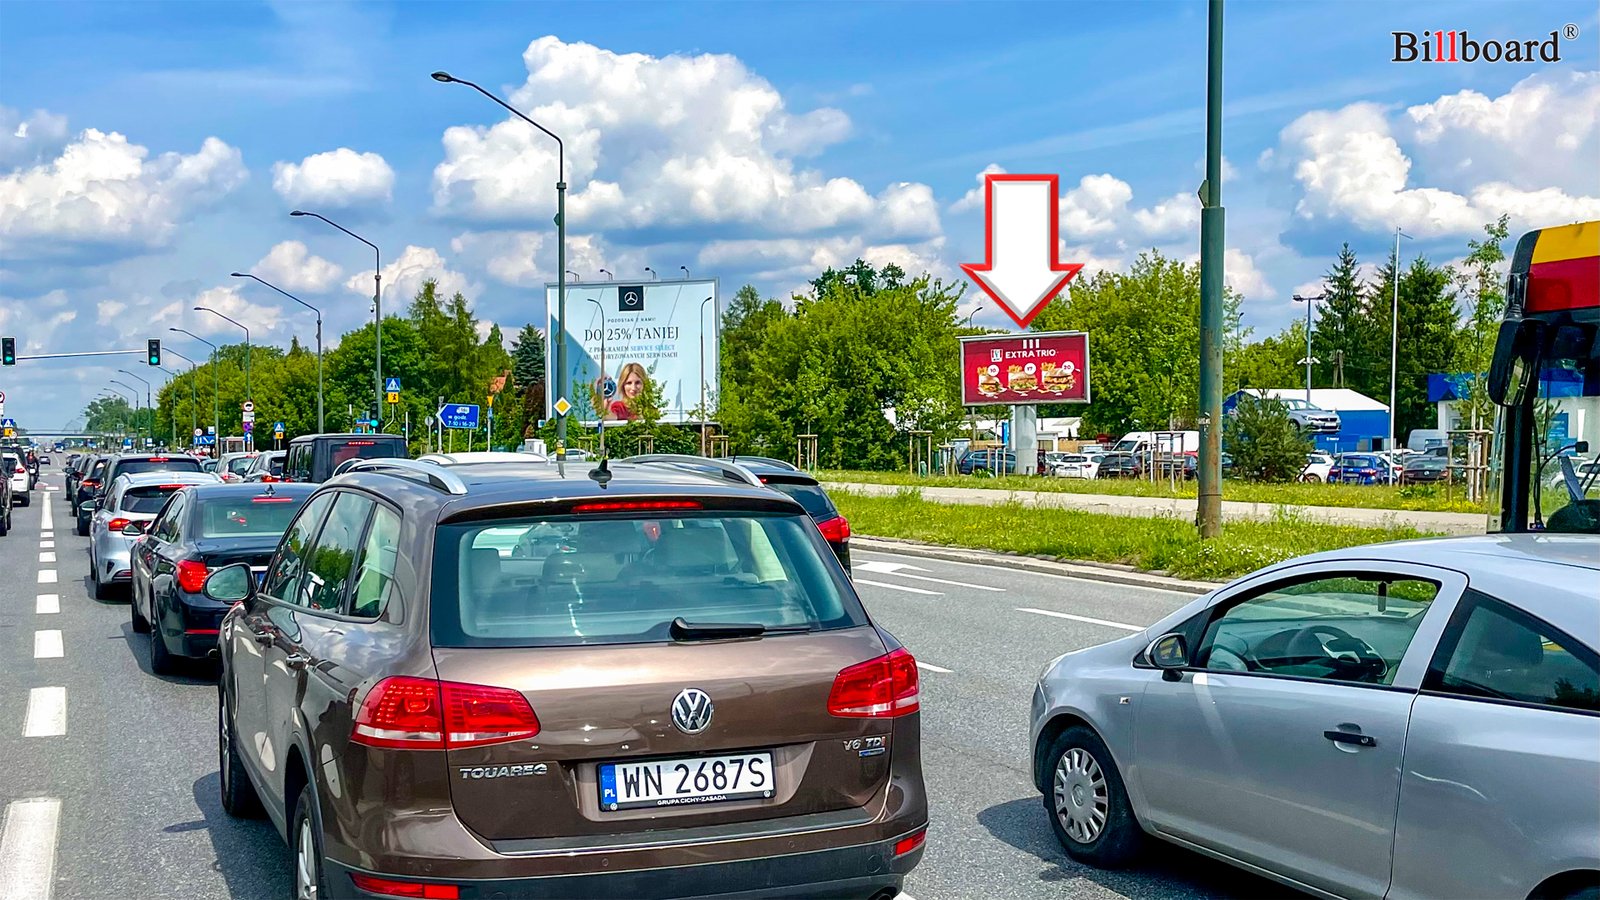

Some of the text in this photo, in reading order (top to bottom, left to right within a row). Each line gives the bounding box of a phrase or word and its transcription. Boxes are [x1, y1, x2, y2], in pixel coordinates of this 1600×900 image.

[585, 326, 679, 341] DO 25% TANIEJ
[1005, 349, 1056, 359] EXTRA TRIO
[843, 736, 886, 751] V6 TDI
[459, 763, 548, 779] TOUAREG
[622, 757, 765, 798] WN 2687S
[604, 788, 616, 798] PL
[657, 795, 727, 806] GRUPA CICHY-ZASADA
